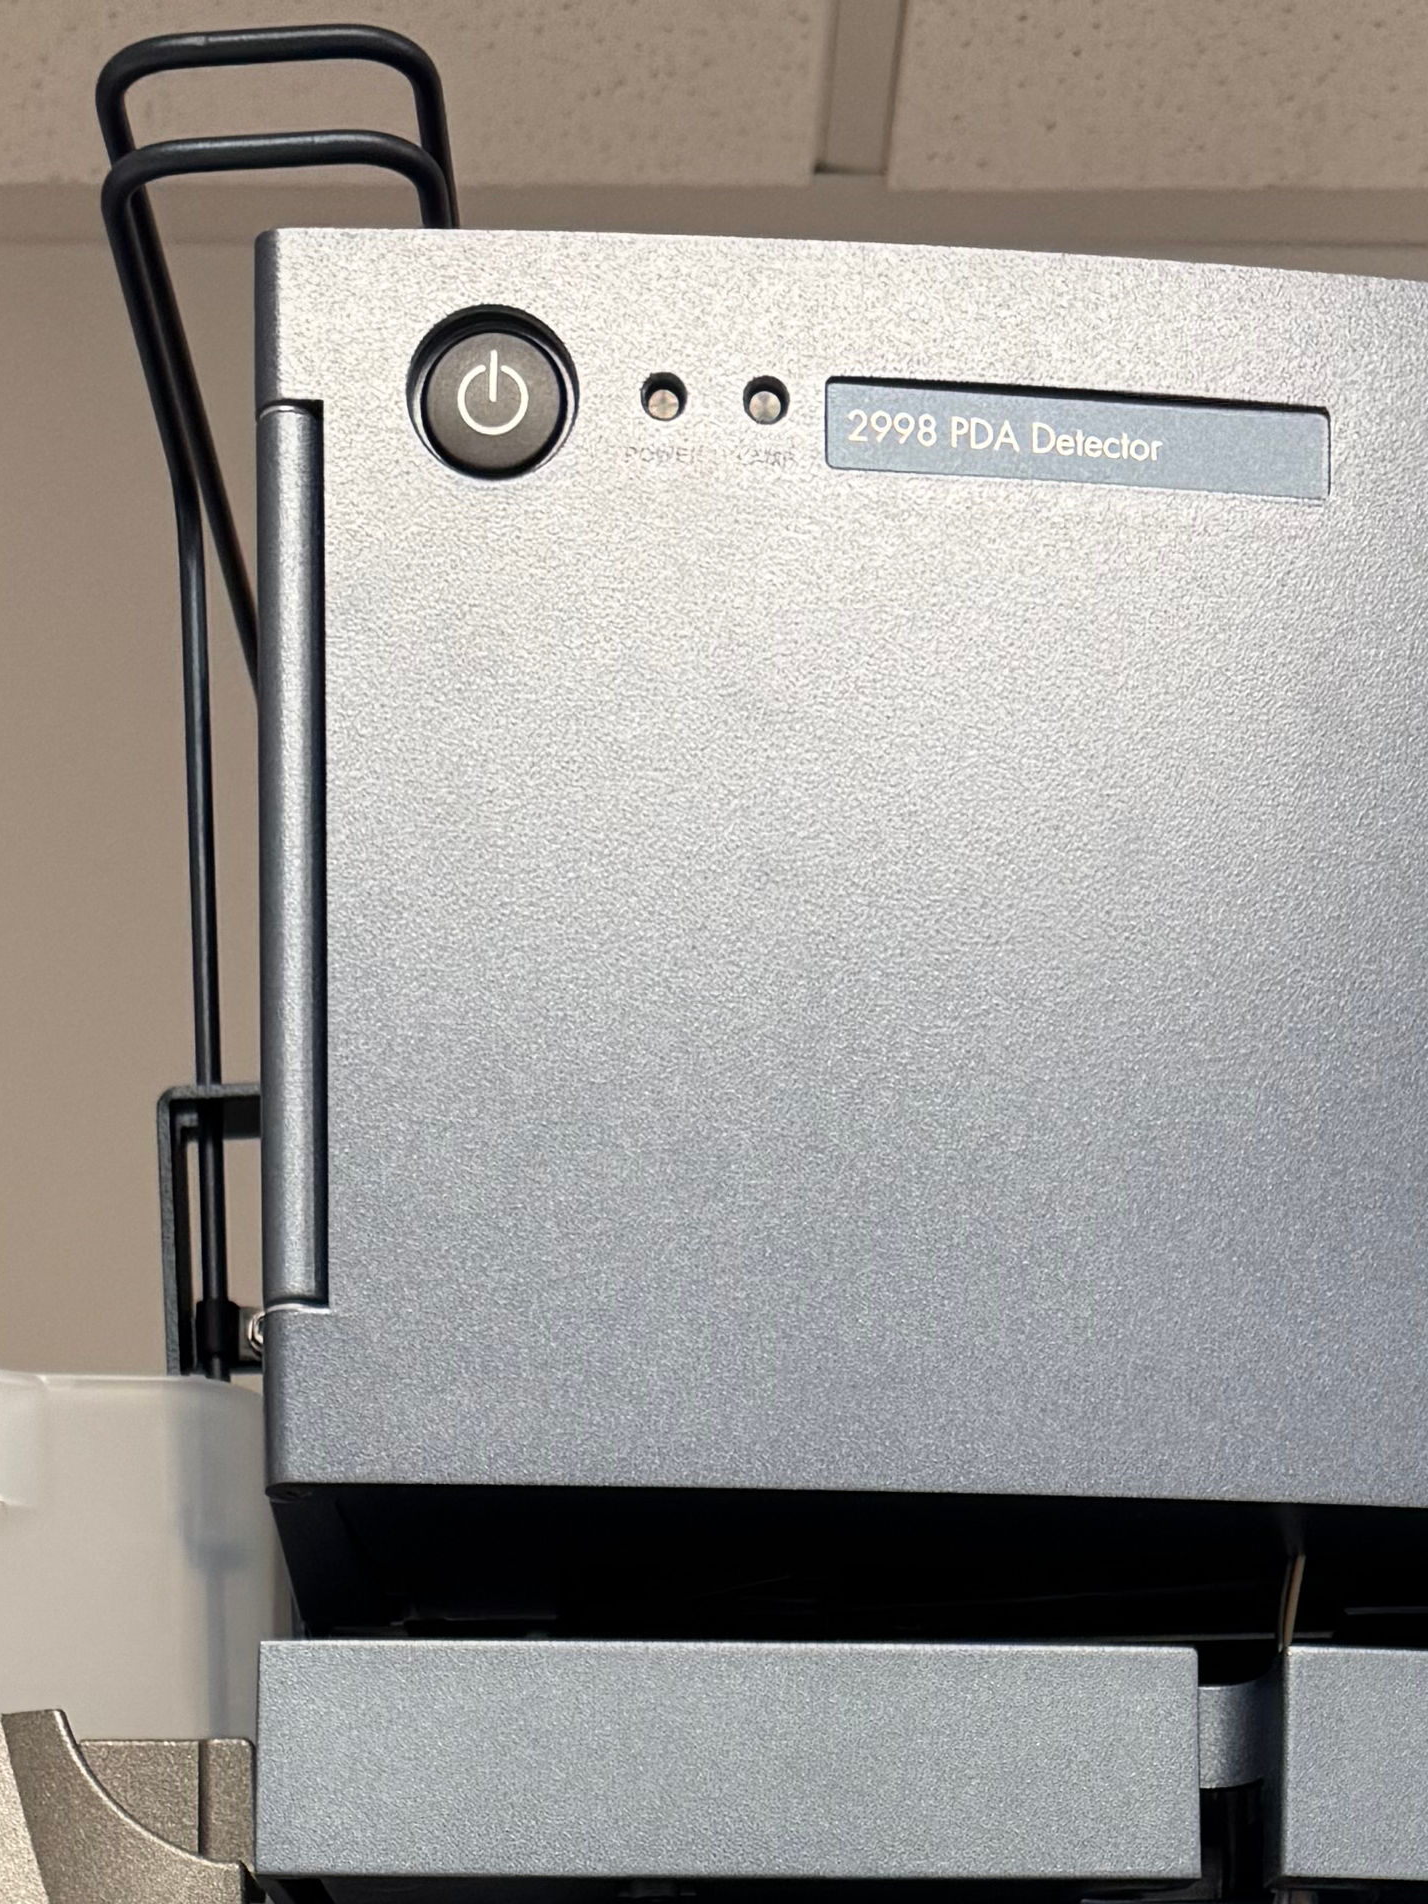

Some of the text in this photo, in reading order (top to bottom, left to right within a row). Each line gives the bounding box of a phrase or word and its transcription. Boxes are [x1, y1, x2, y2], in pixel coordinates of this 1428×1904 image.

[846, 408, 1163, 462] 2998 PDA Detector
